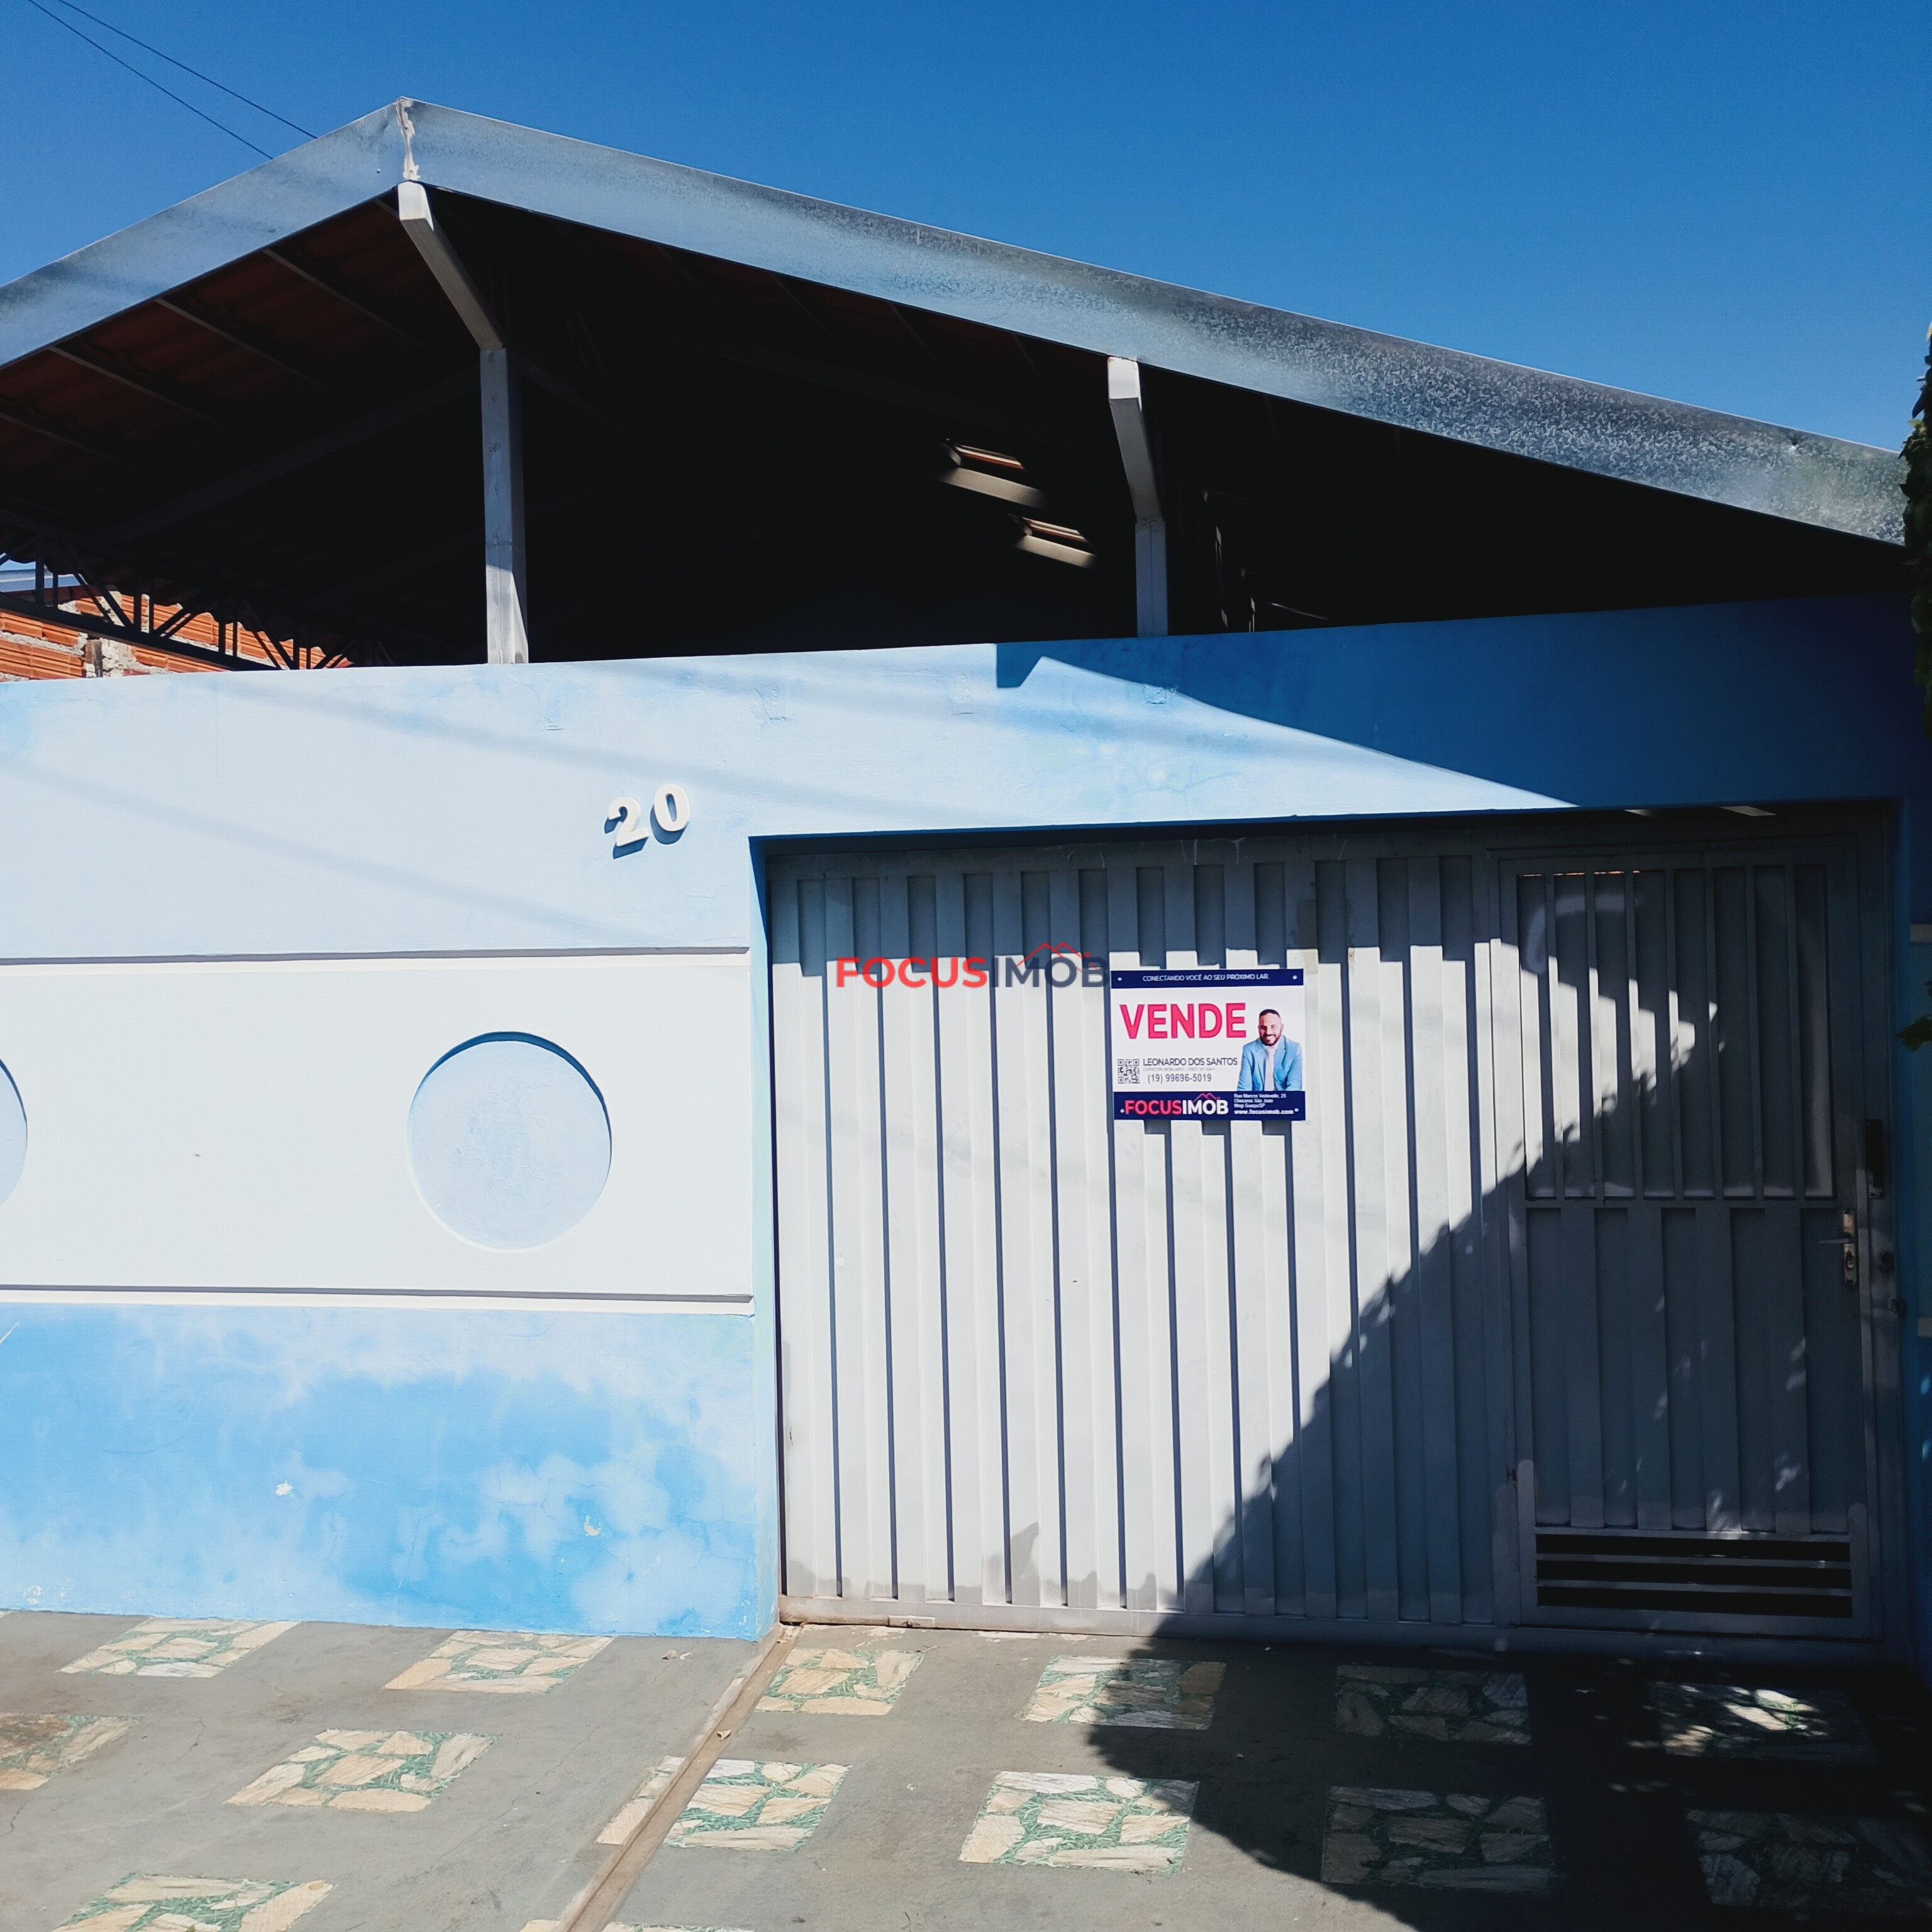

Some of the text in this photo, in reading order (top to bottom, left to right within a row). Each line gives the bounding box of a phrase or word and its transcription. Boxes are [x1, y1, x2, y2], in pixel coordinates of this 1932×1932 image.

[608, 784, 691, 847] 20
[1119, 1002, 1247, 1040] VENDE
[1143, 1058, 1187, 1066] LEONARDO
[1206, 1057, 1238, 1065] SANTOS
[1148, 1073, 1212, 1084] (19) 99696-5019
[1124, 1099, 1228, 1115] FOCUSIMOB
